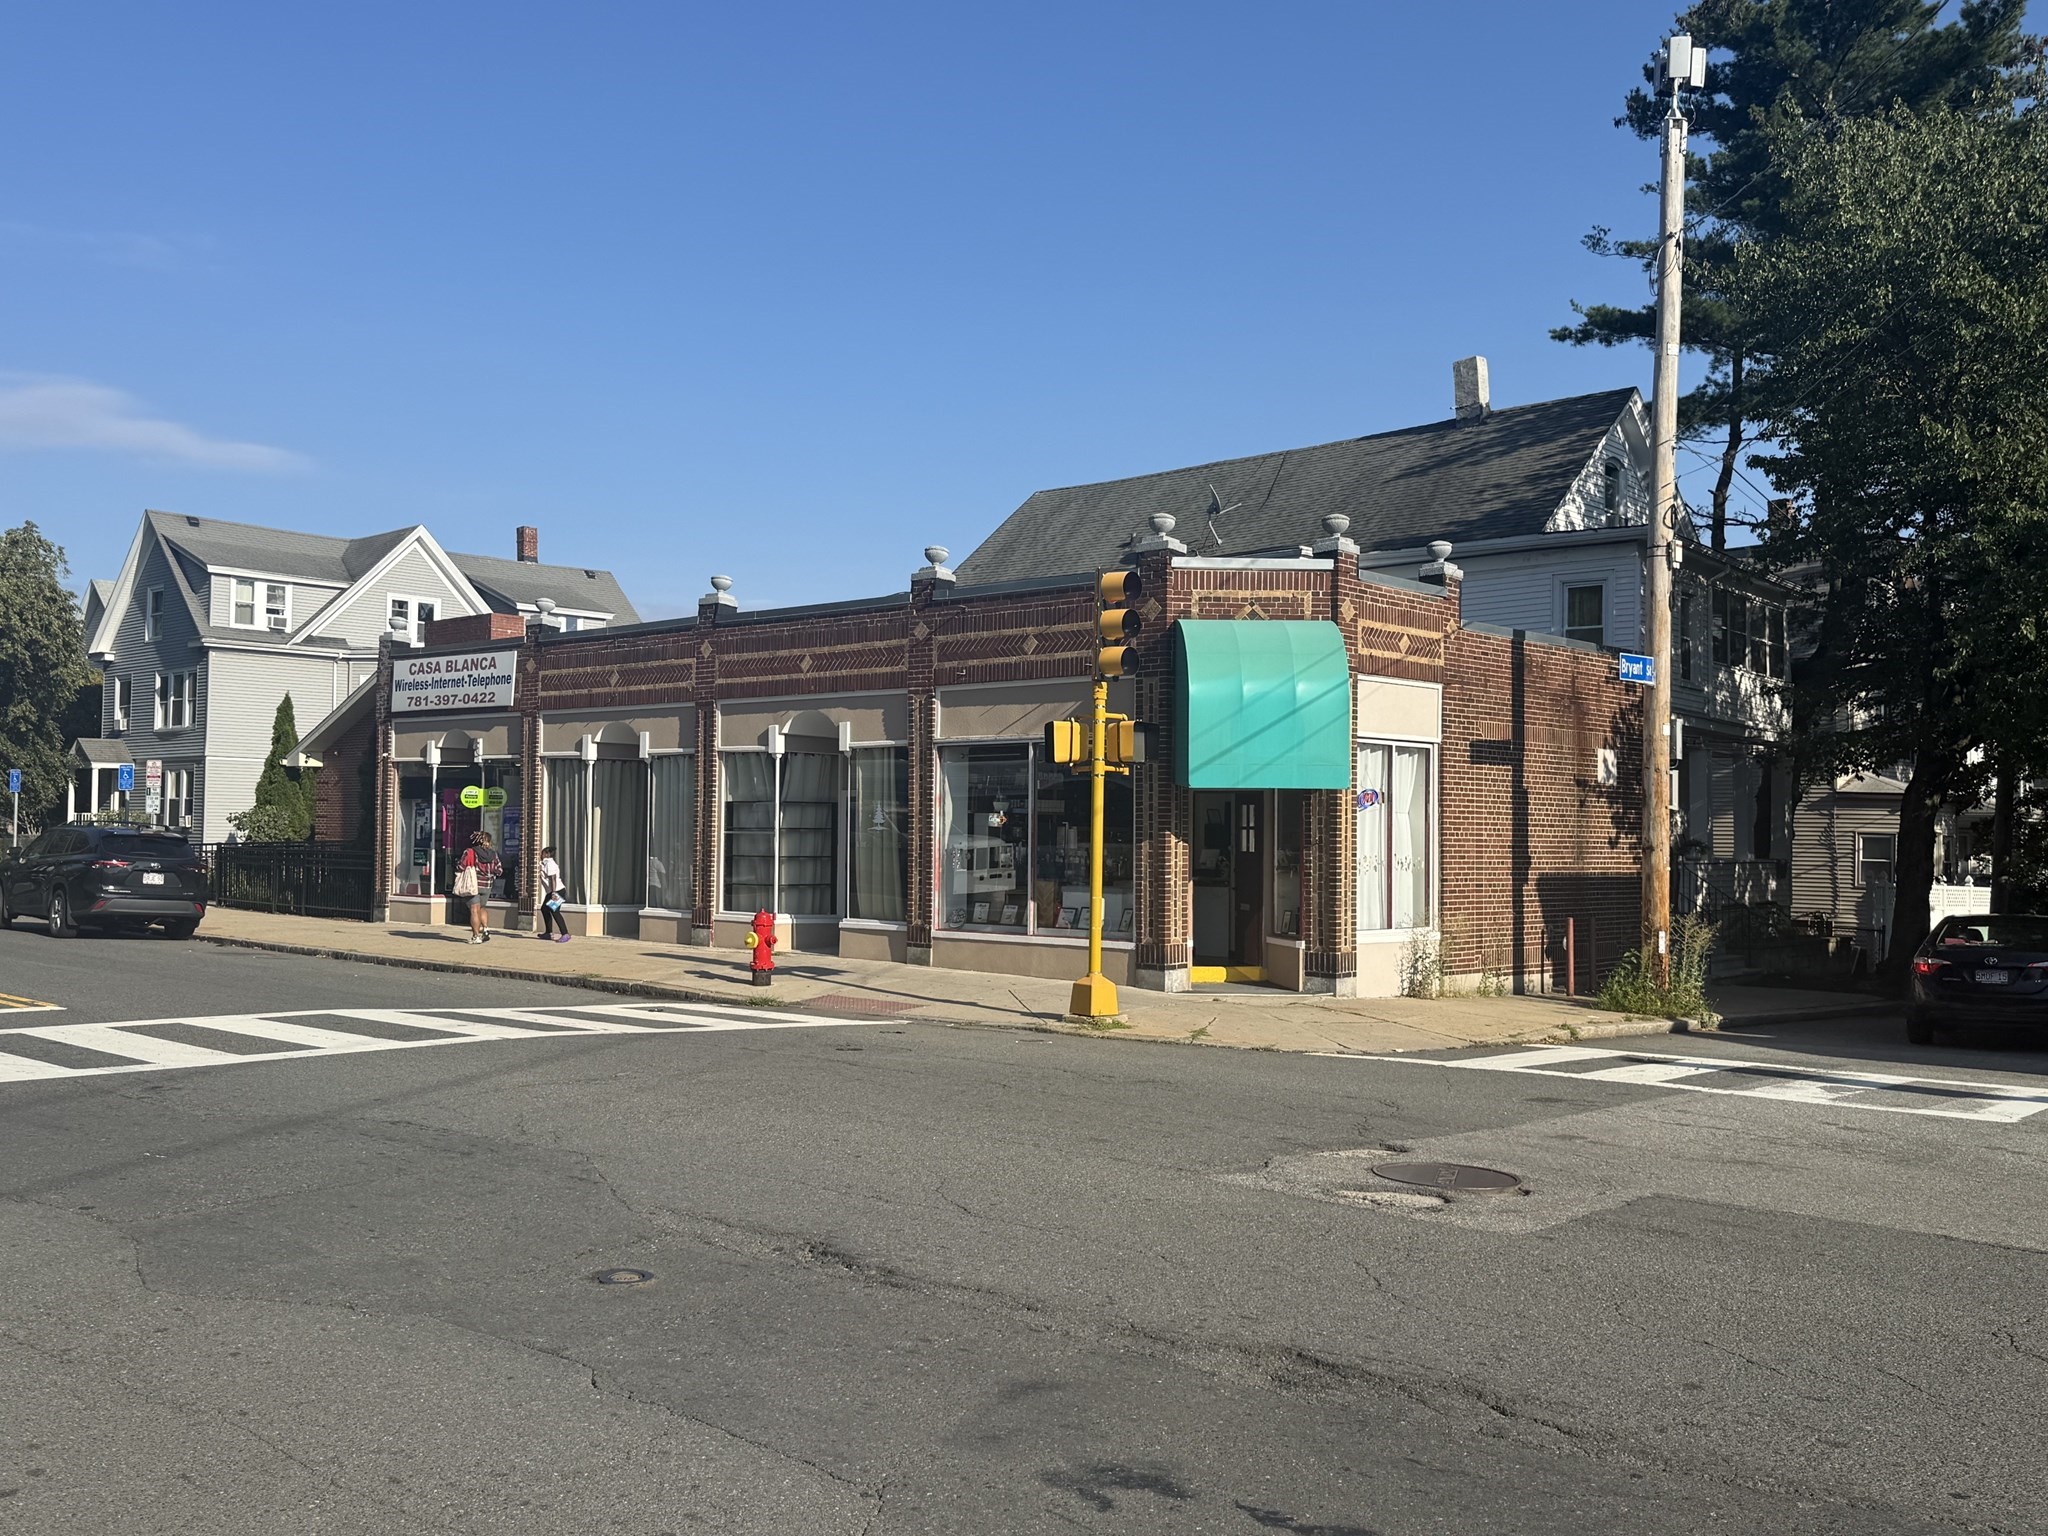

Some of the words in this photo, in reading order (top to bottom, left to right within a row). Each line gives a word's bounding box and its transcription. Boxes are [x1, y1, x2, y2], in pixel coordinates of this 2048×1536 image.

[409, 661, 441, 675] CASA
[446, 656, 497, 673] BLANCA
[1621, 658, 1643, 678] Bryant
[394, 673, 512, 692] Wireless-Internet-Telephone
[407, 692, 496, 707] 781-397-0422
